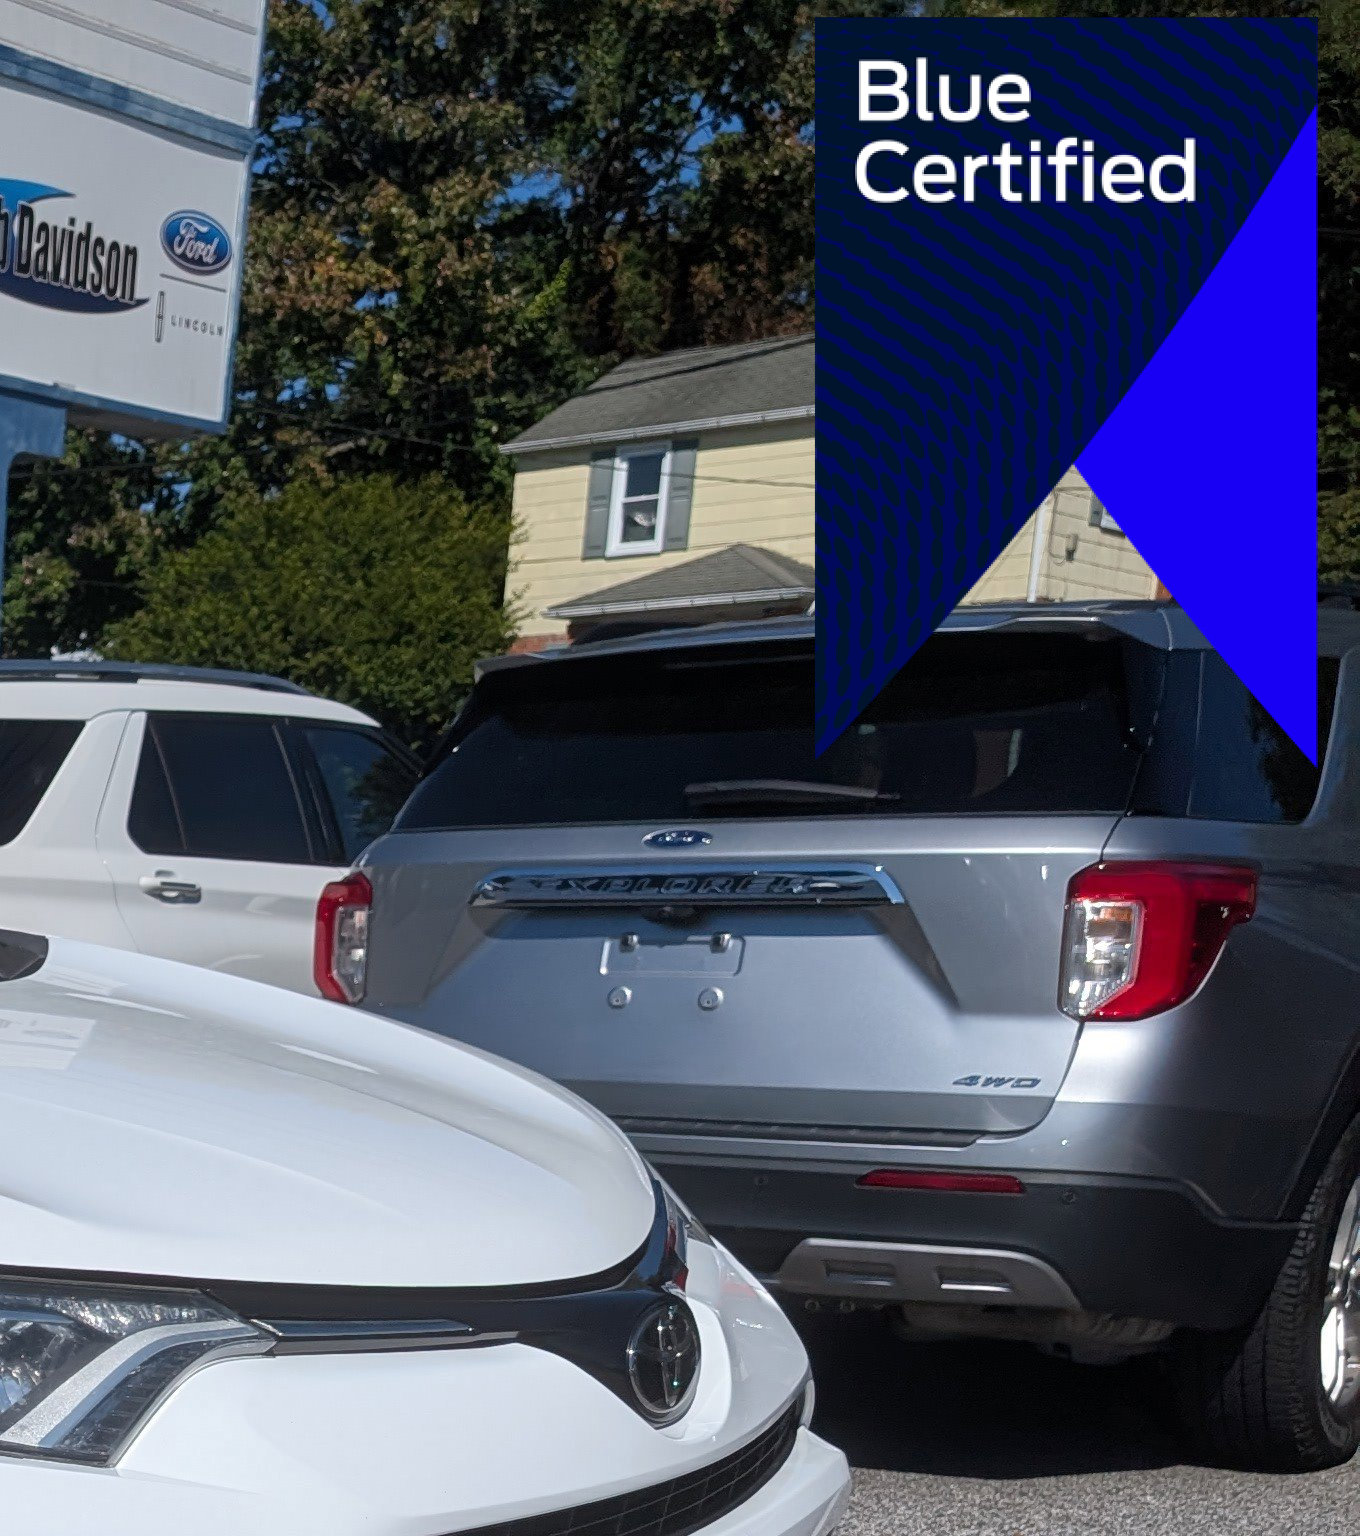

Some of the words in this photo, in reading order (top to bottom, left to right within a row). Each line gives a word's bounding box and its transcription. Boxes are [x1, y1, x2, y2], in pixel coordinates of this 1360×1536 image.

[13, 200, 139, 305] Davidson
[173, 218, 220, 264] Ford
[170, 314, 223, 336] LINCOLN
[952, 1075, 1041, 1088] 4WD
